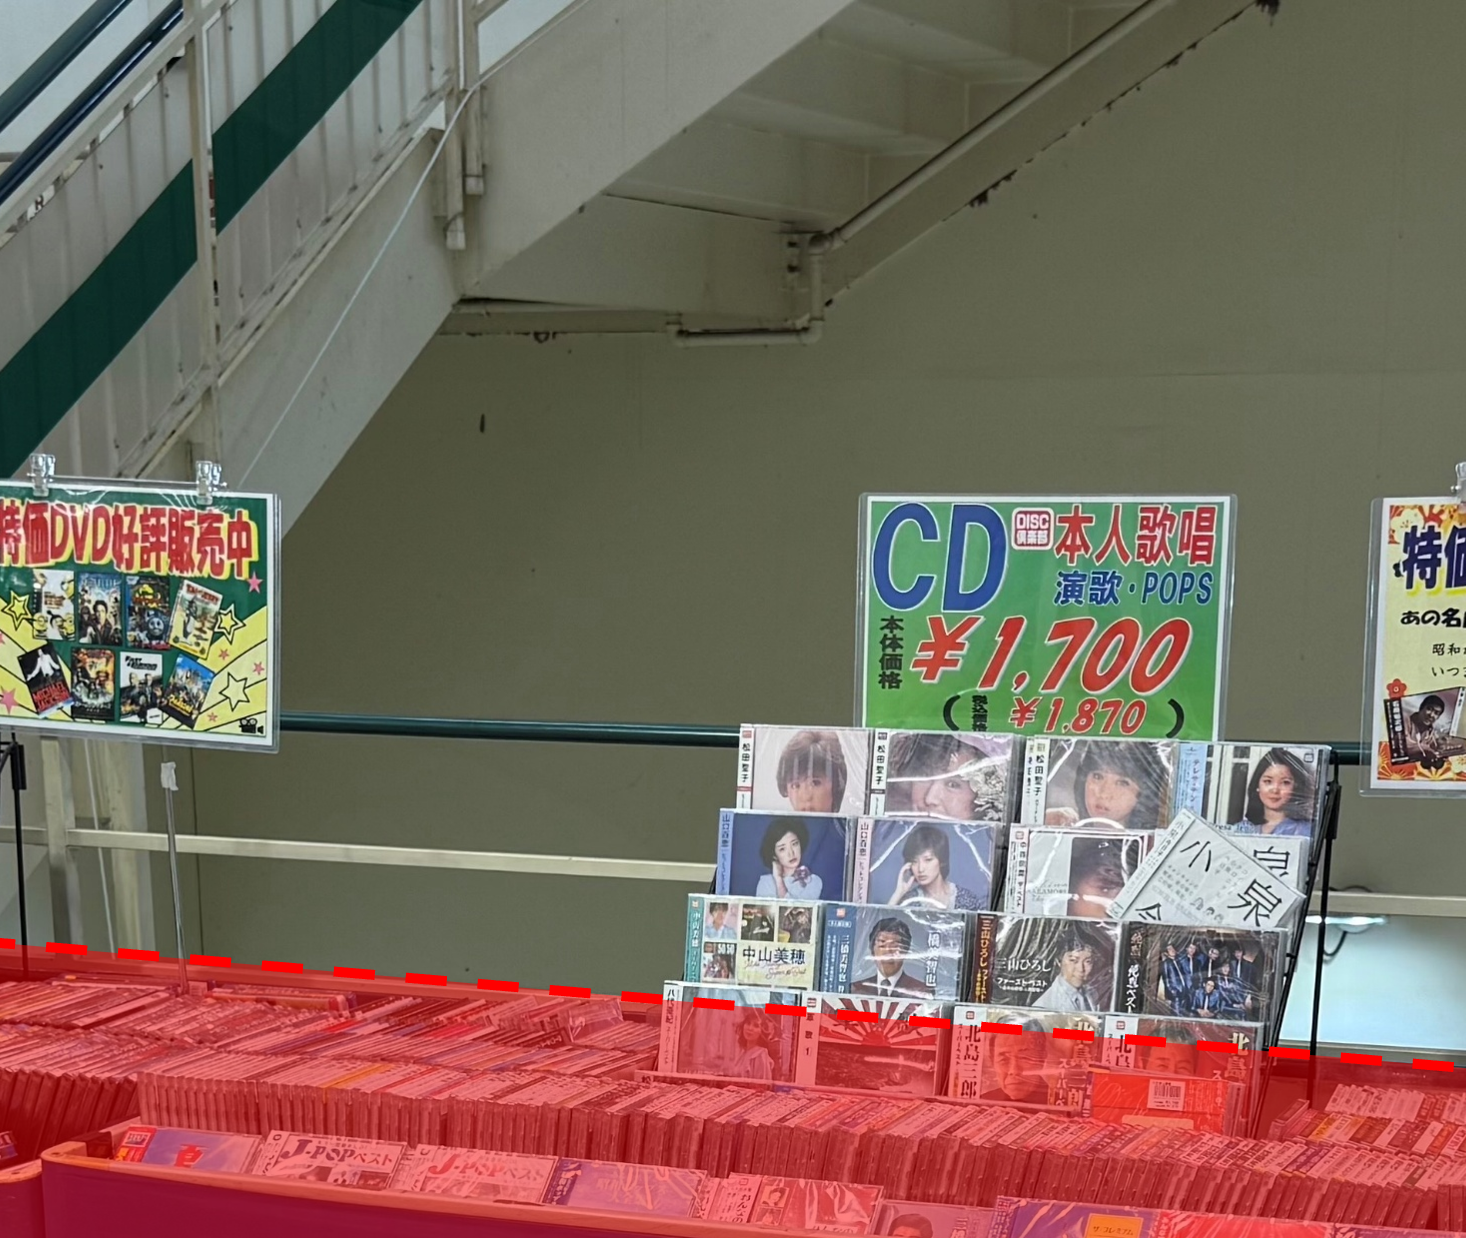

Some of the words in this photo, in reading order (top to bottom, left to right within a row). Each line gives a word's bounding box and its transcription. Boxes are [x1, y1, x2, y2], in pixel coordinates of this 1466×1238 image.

[1016, 513, 1049, 528] DISC
[1053, 503, 1217, 566] 本人歌唱
[871, 501, 1009, 613] CD
[1052, 570, 1214, 606] 演歌・POPS
[878, 615, 904, 690] 本体価格
[909, 615, 1193, 695] ¥1,700
[1008, 696, 1147, 736] ¥1,870
[741, 946, 807, 966] 中山美穂
[994, 957, 1052, 972] 三山ひろし
[960, 1023, 982, 1100] 北島三郎
[280, 1138, 394, 1167] J-POPベスト
